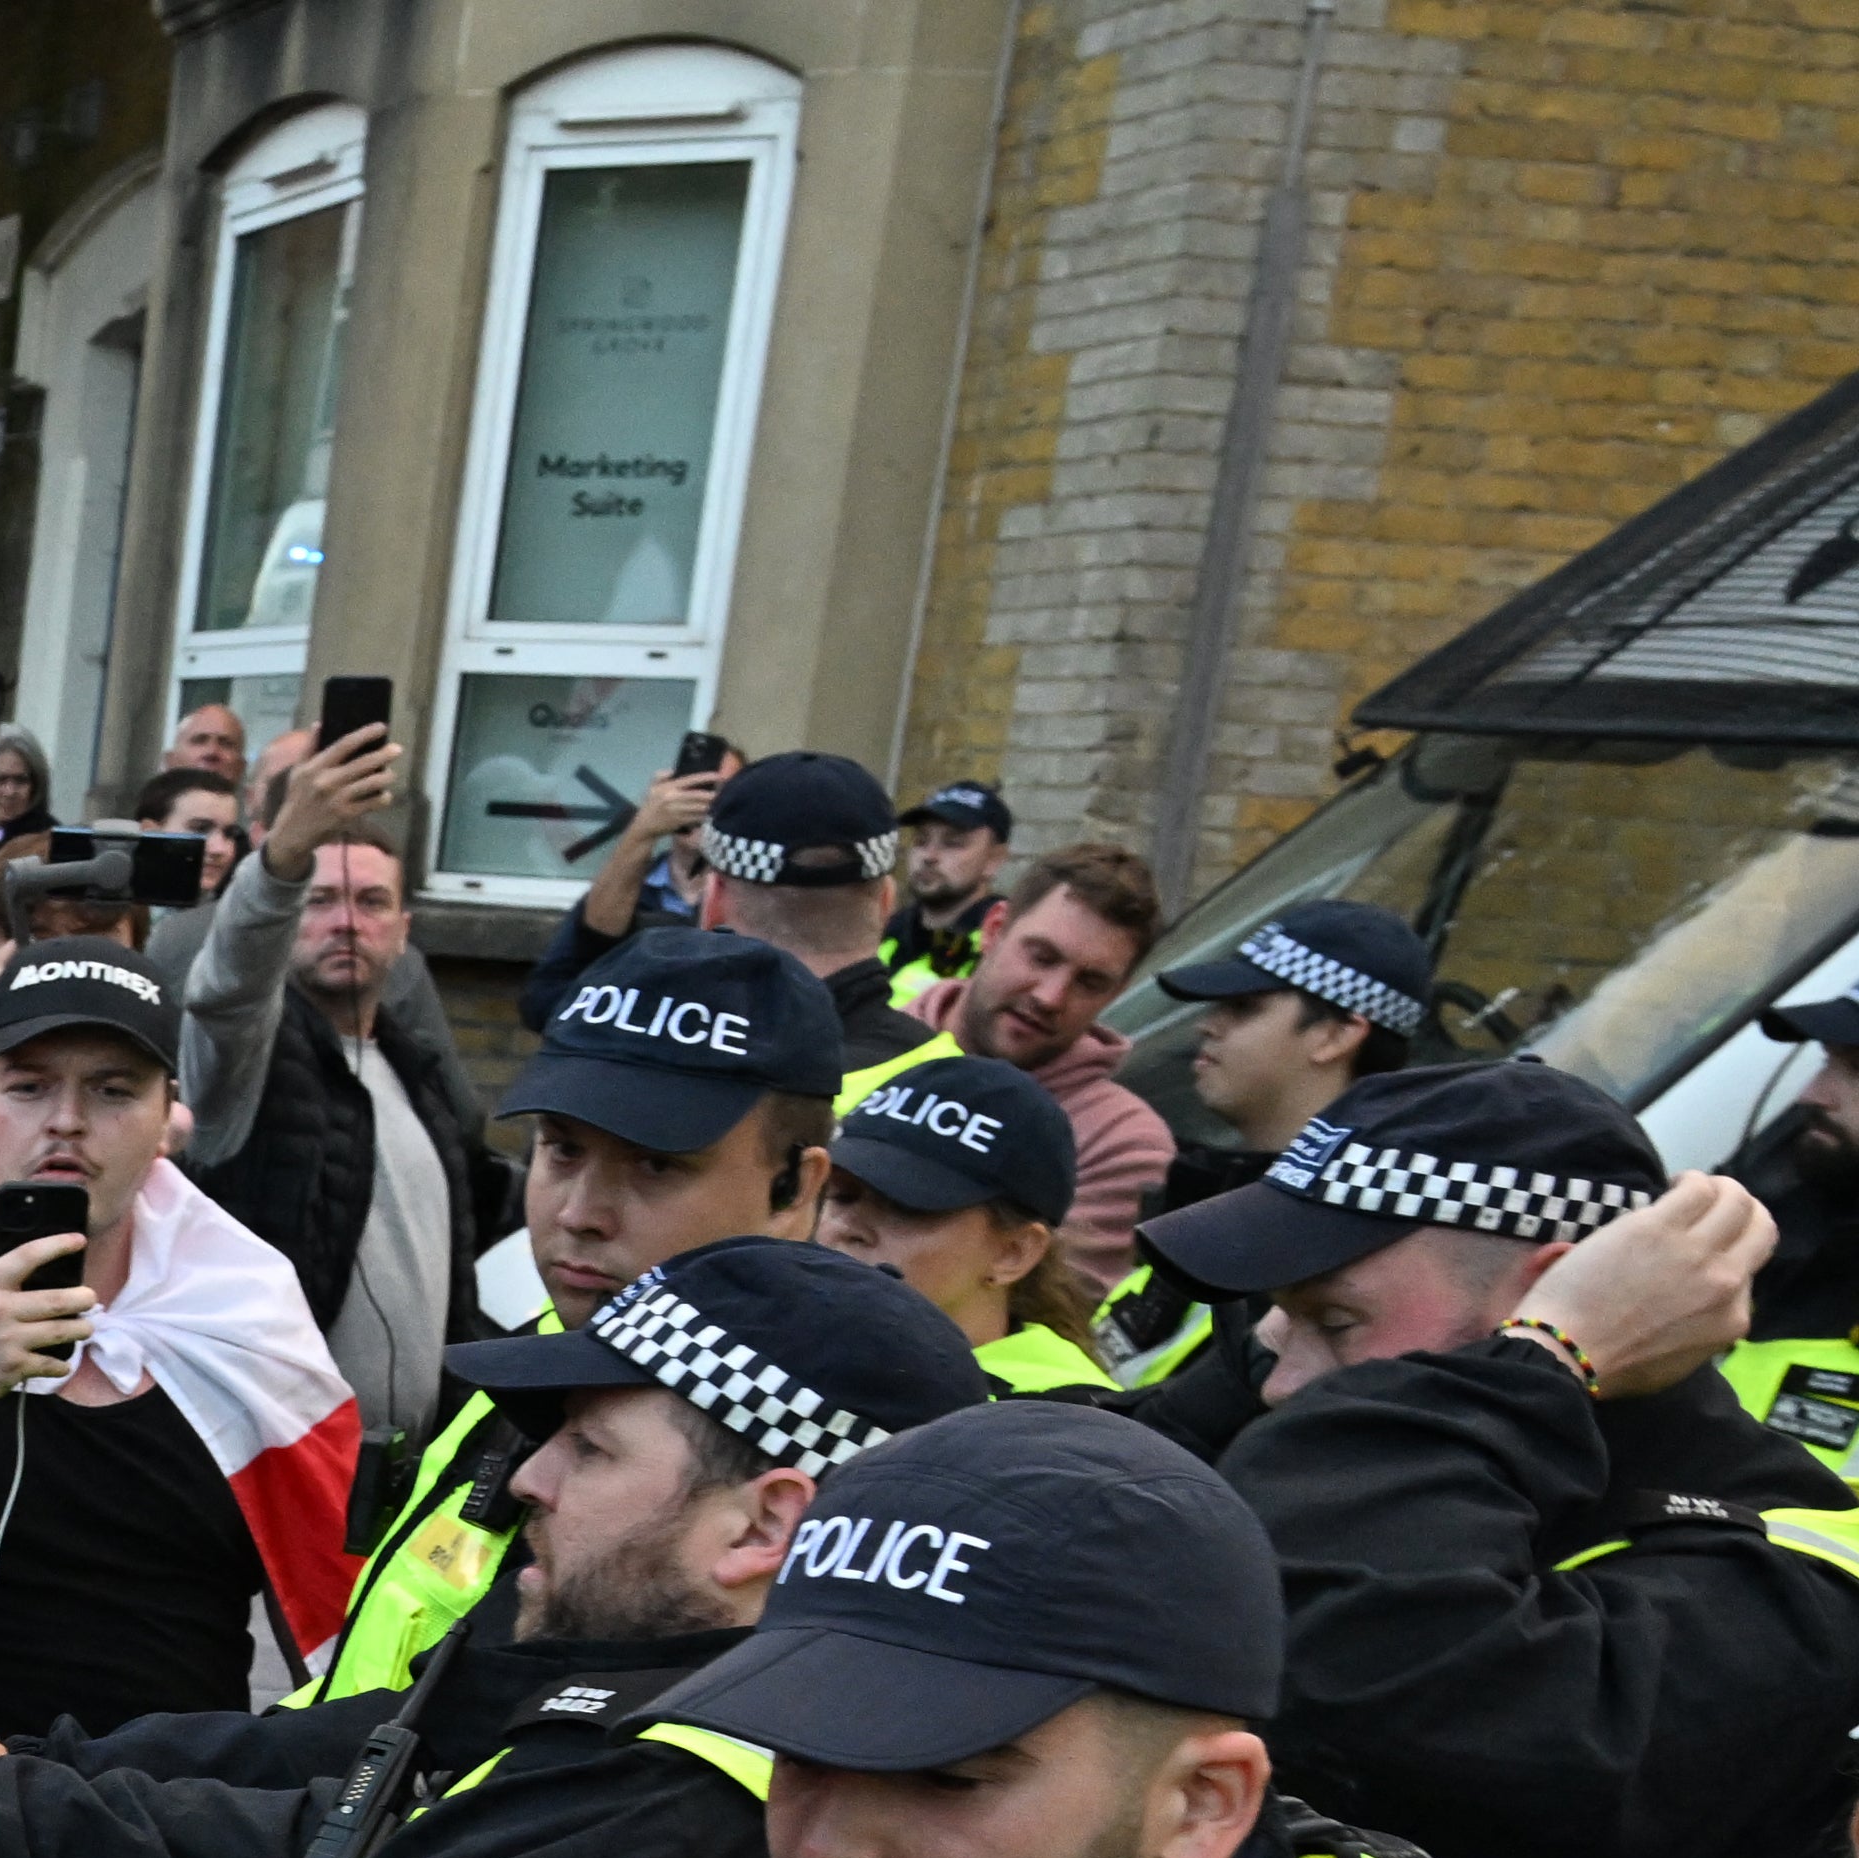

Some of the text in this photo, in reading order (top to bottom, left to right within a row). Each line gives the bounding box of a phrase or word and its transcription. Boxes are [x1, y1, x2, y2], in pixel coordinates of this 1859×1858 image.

[537, 453, 688, 486] Marketing
[572, 490, 645, 519] Suite
[9, 960, 162, 1005] MONTIREX
[558, 984, 750, 1056] POLICE
[776, 1515, 992, 1606] POLICE
